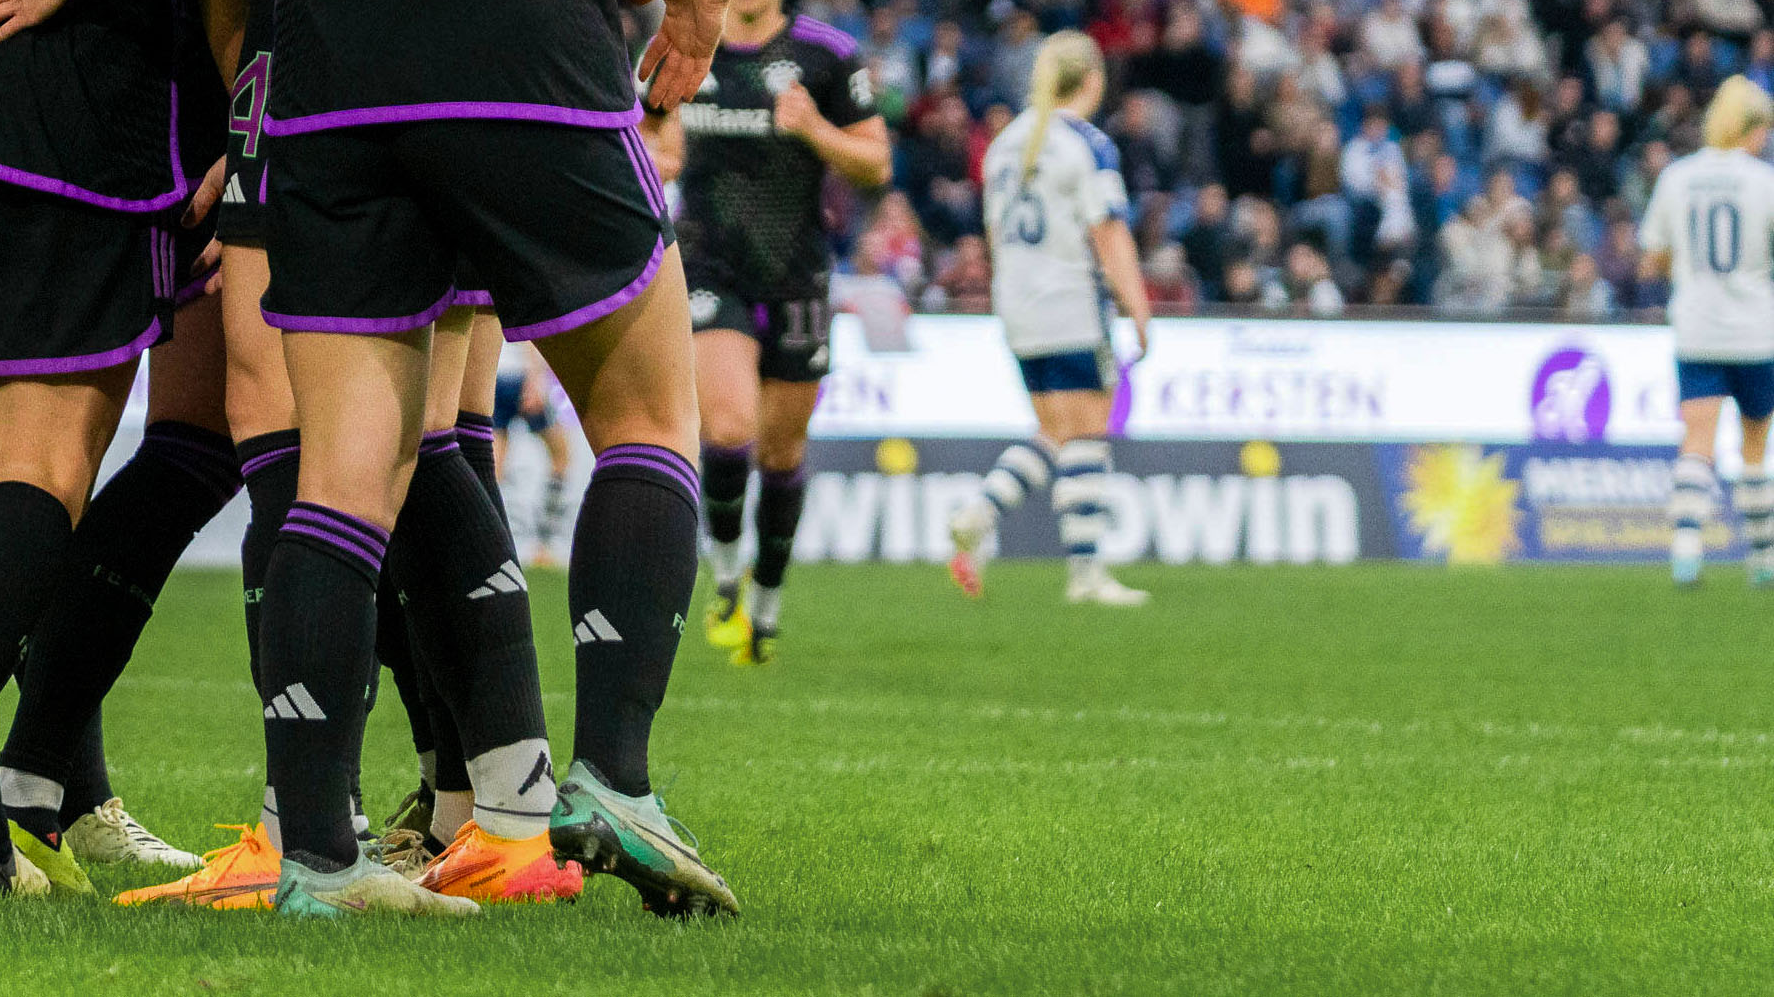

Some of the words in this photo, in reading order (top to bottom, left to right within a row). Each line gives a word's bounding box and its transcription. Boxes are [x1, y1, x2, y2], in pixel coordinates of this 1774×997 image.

[228, 50, 273, 158] 4
[1688, 200, 1743, 275] 10
[1158, 365, 1385, 423] KERSTEN
